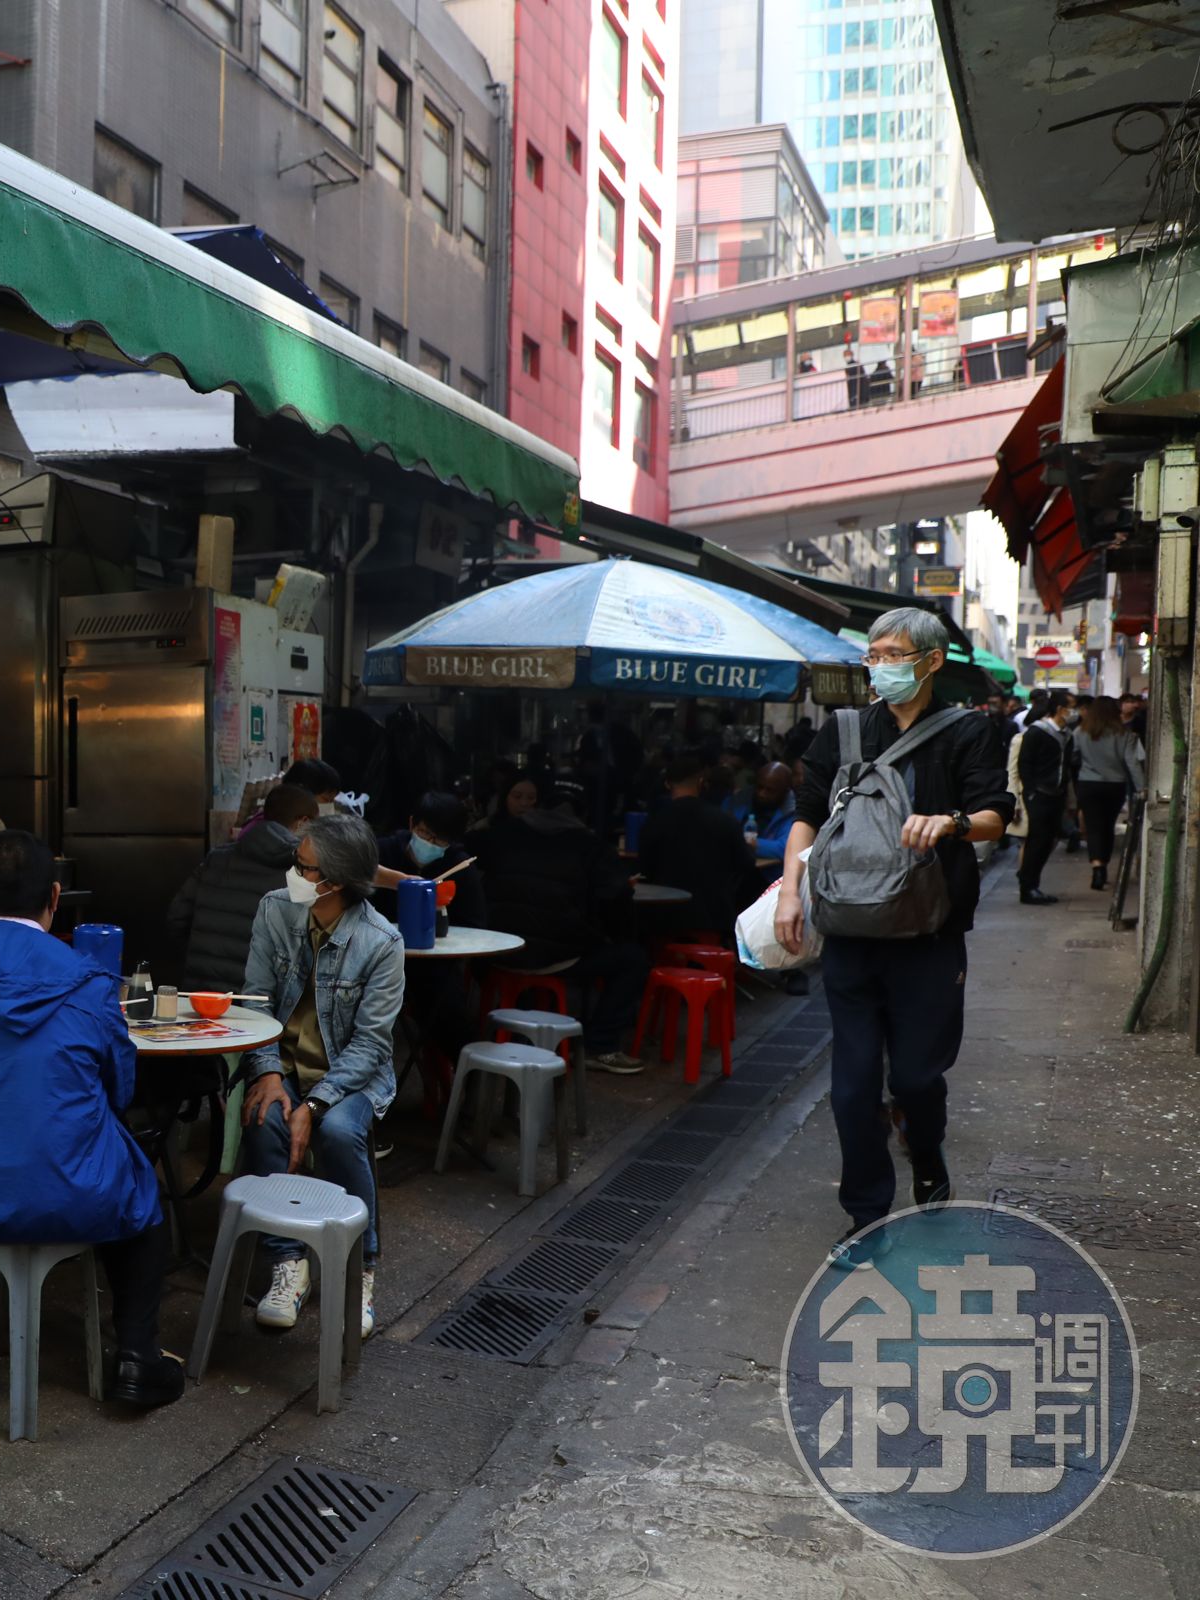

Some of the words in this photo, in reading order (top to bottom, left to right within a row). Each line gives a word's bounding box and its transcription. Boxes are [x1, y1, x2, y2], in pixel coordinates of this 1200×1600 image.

[426, 656, 484, 677] BLUE
[491, 656, 549, 678] GIRL
[615, 657, 688, 684] BLUE
[694, 663, 762, 689] GIRL
